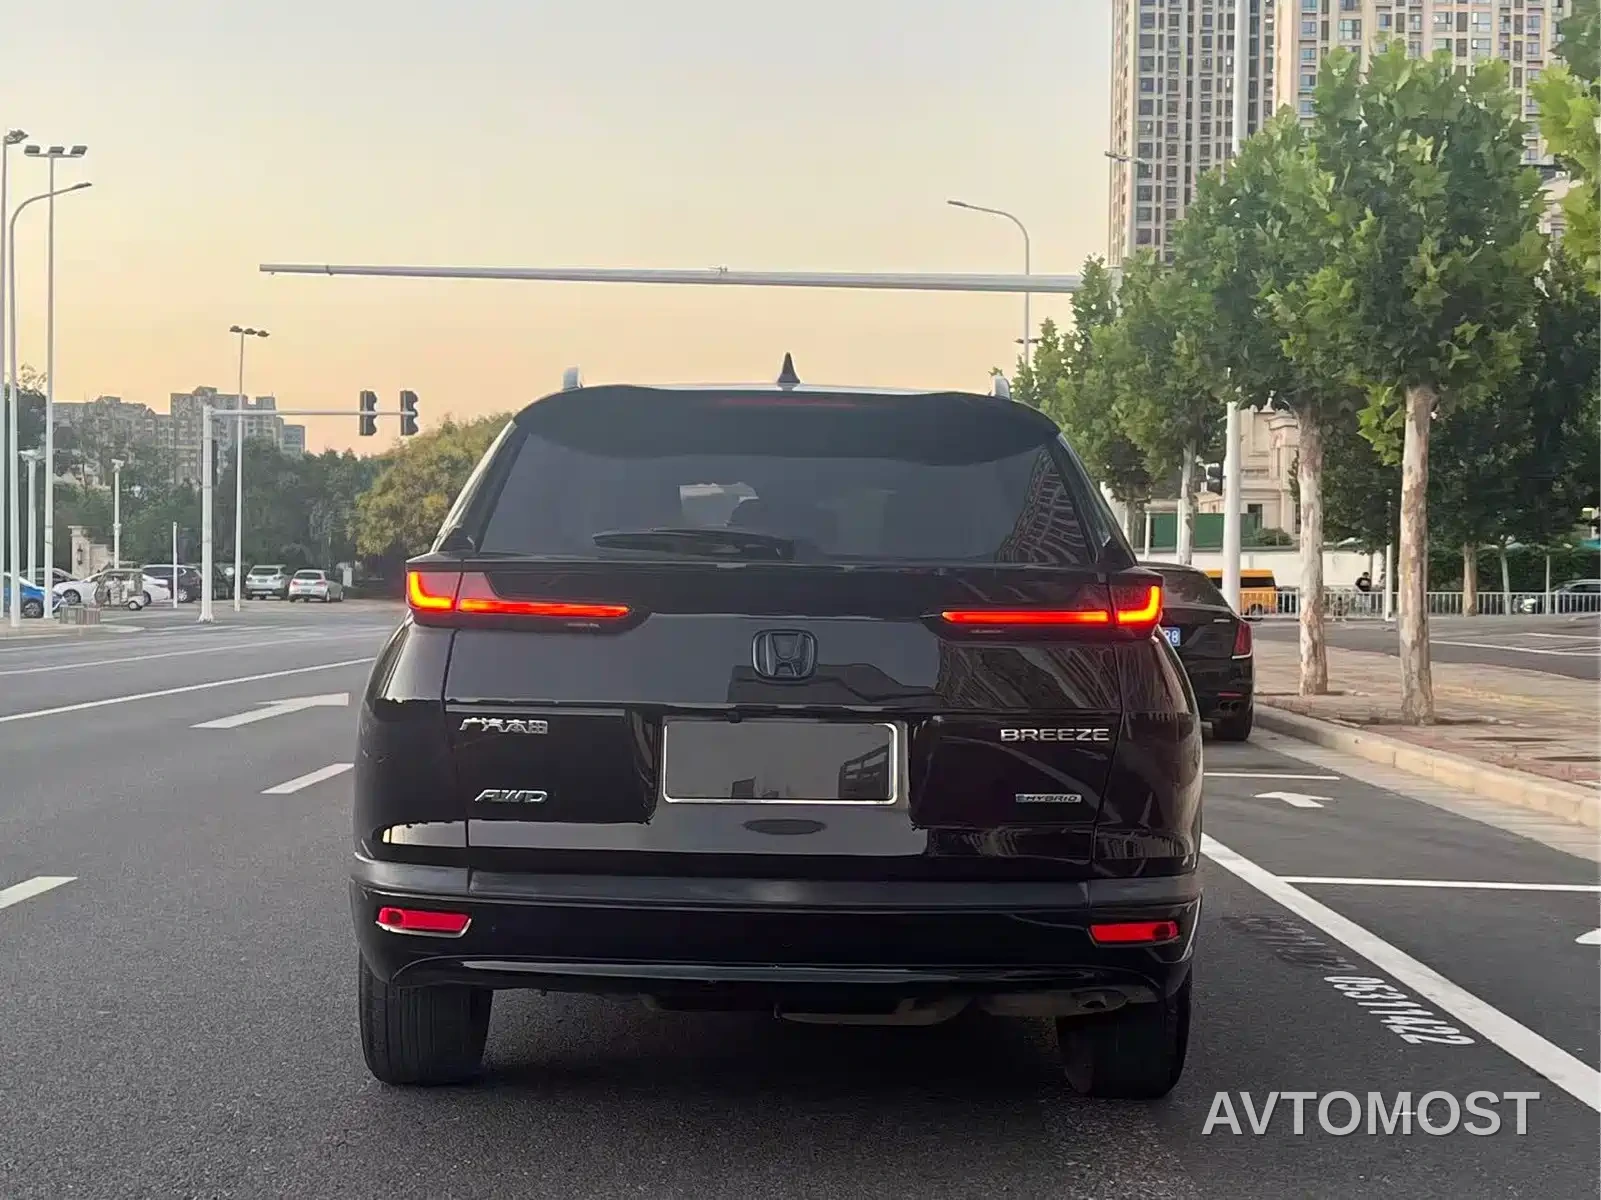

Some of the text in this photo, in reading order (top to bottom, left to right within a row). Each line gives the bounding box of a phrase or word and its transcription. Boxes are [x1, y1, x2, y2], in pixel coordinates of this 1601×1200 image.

[459, 717, 548, 734] 广汽本田
[1000, 728, 1110, 741] BREEZE
[474, 789, 548, 802] AWD
[1323, 975, 1476, 1045] 05311422
